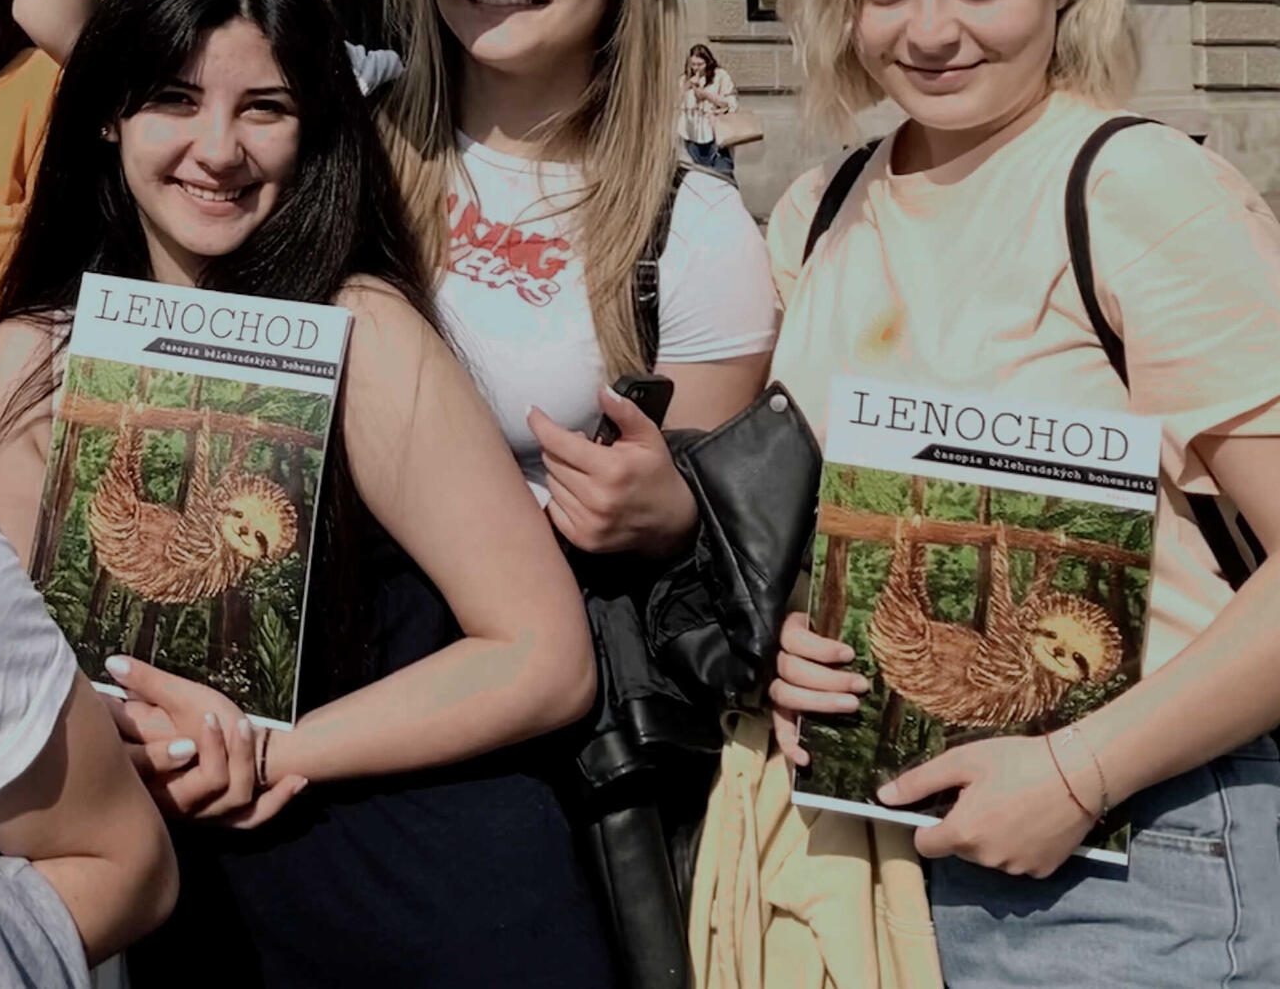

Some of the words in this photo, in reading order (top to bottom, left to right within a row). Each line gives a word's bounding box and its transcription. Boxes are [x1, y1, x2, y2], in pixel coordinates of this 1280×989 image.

[94, 289, 320, 350] LENOCHOD
[159, 341, 200, 357] časopis
[849, 390, 1129, 462] LENOCHOD
[933, 448, 983, 466] časopis
[989, 456, 1082, 483] bělehradských
[1088, 472, 1155, 492] bohemistů
